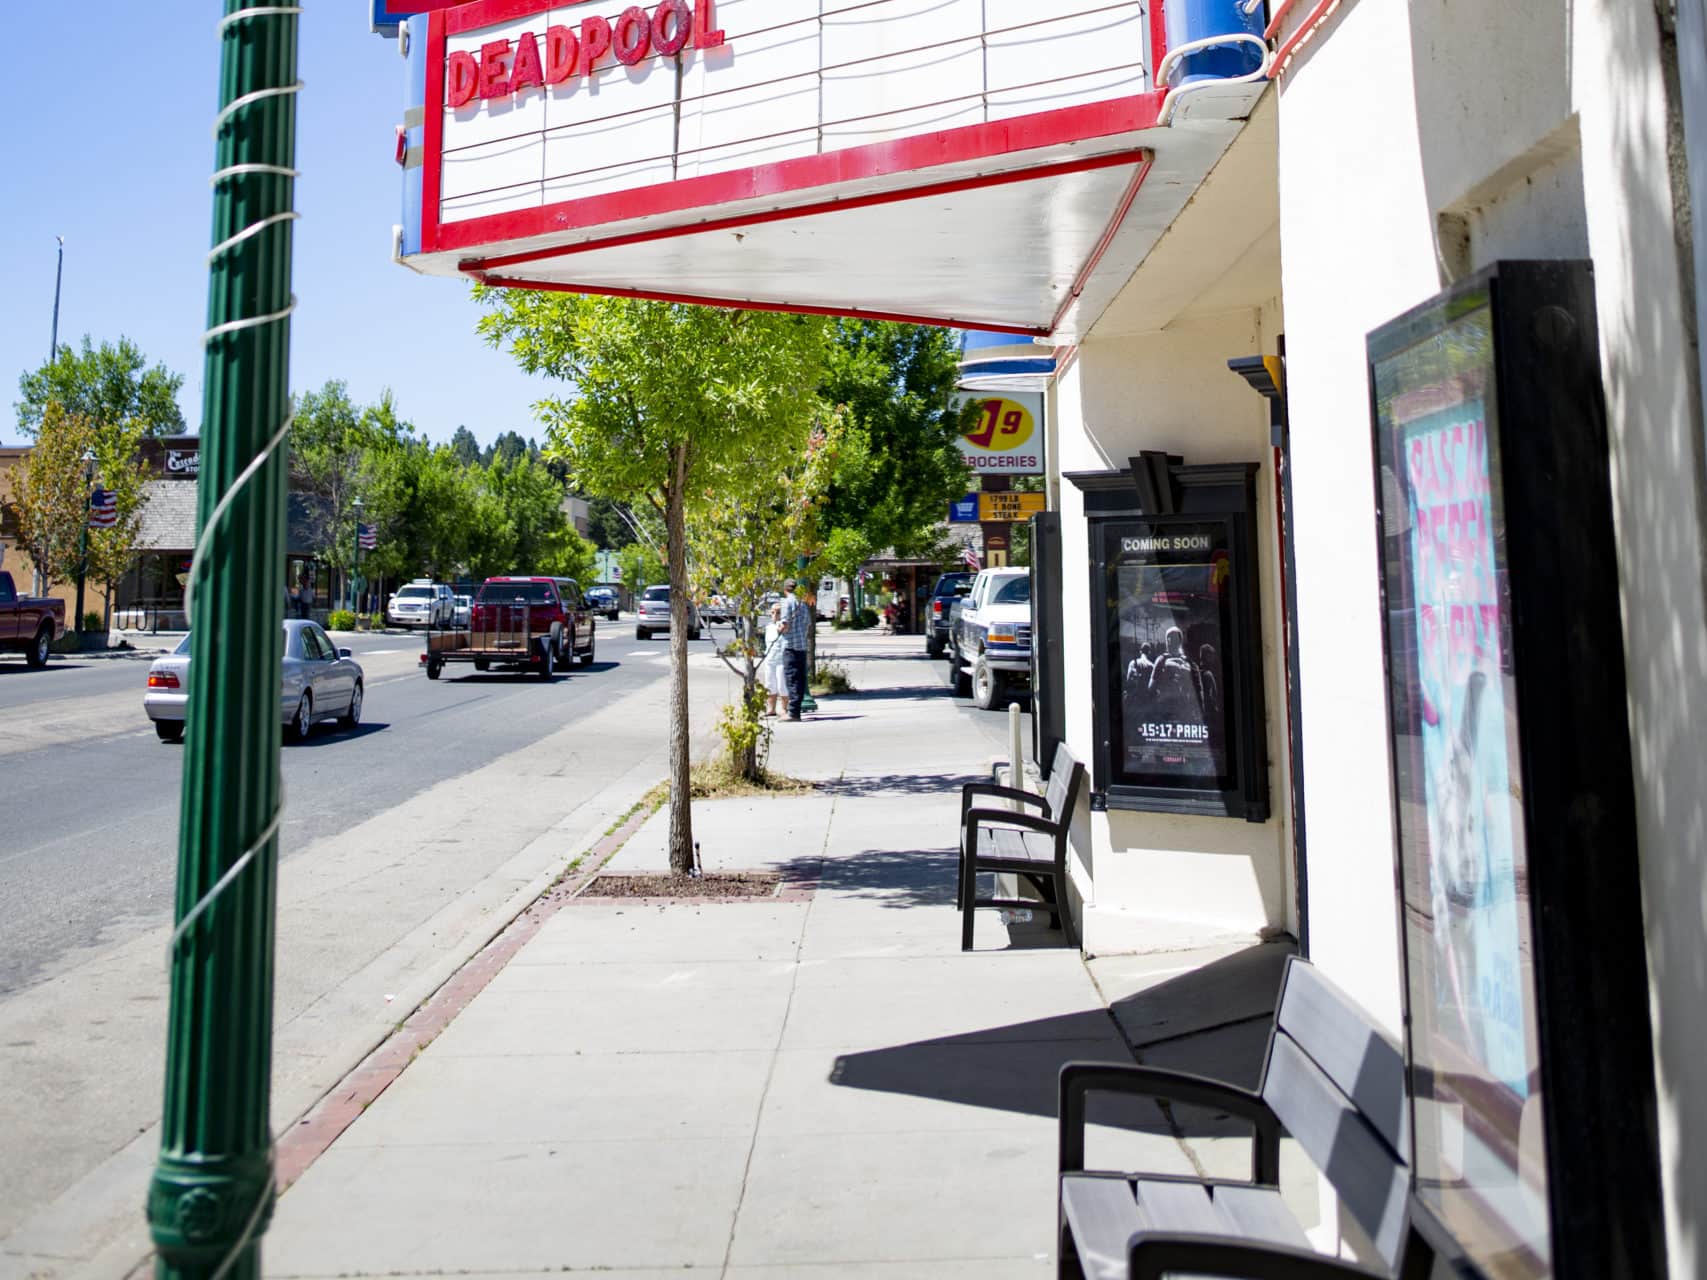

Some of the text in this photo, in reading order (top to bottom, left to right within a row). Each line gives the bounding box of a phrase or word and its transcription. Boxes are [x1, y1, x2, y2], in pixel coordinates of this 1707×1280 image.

[1123, 536, 1209, 551] COMING SOON
[1141, 723, 1209, 739] 15:17 PARIS
